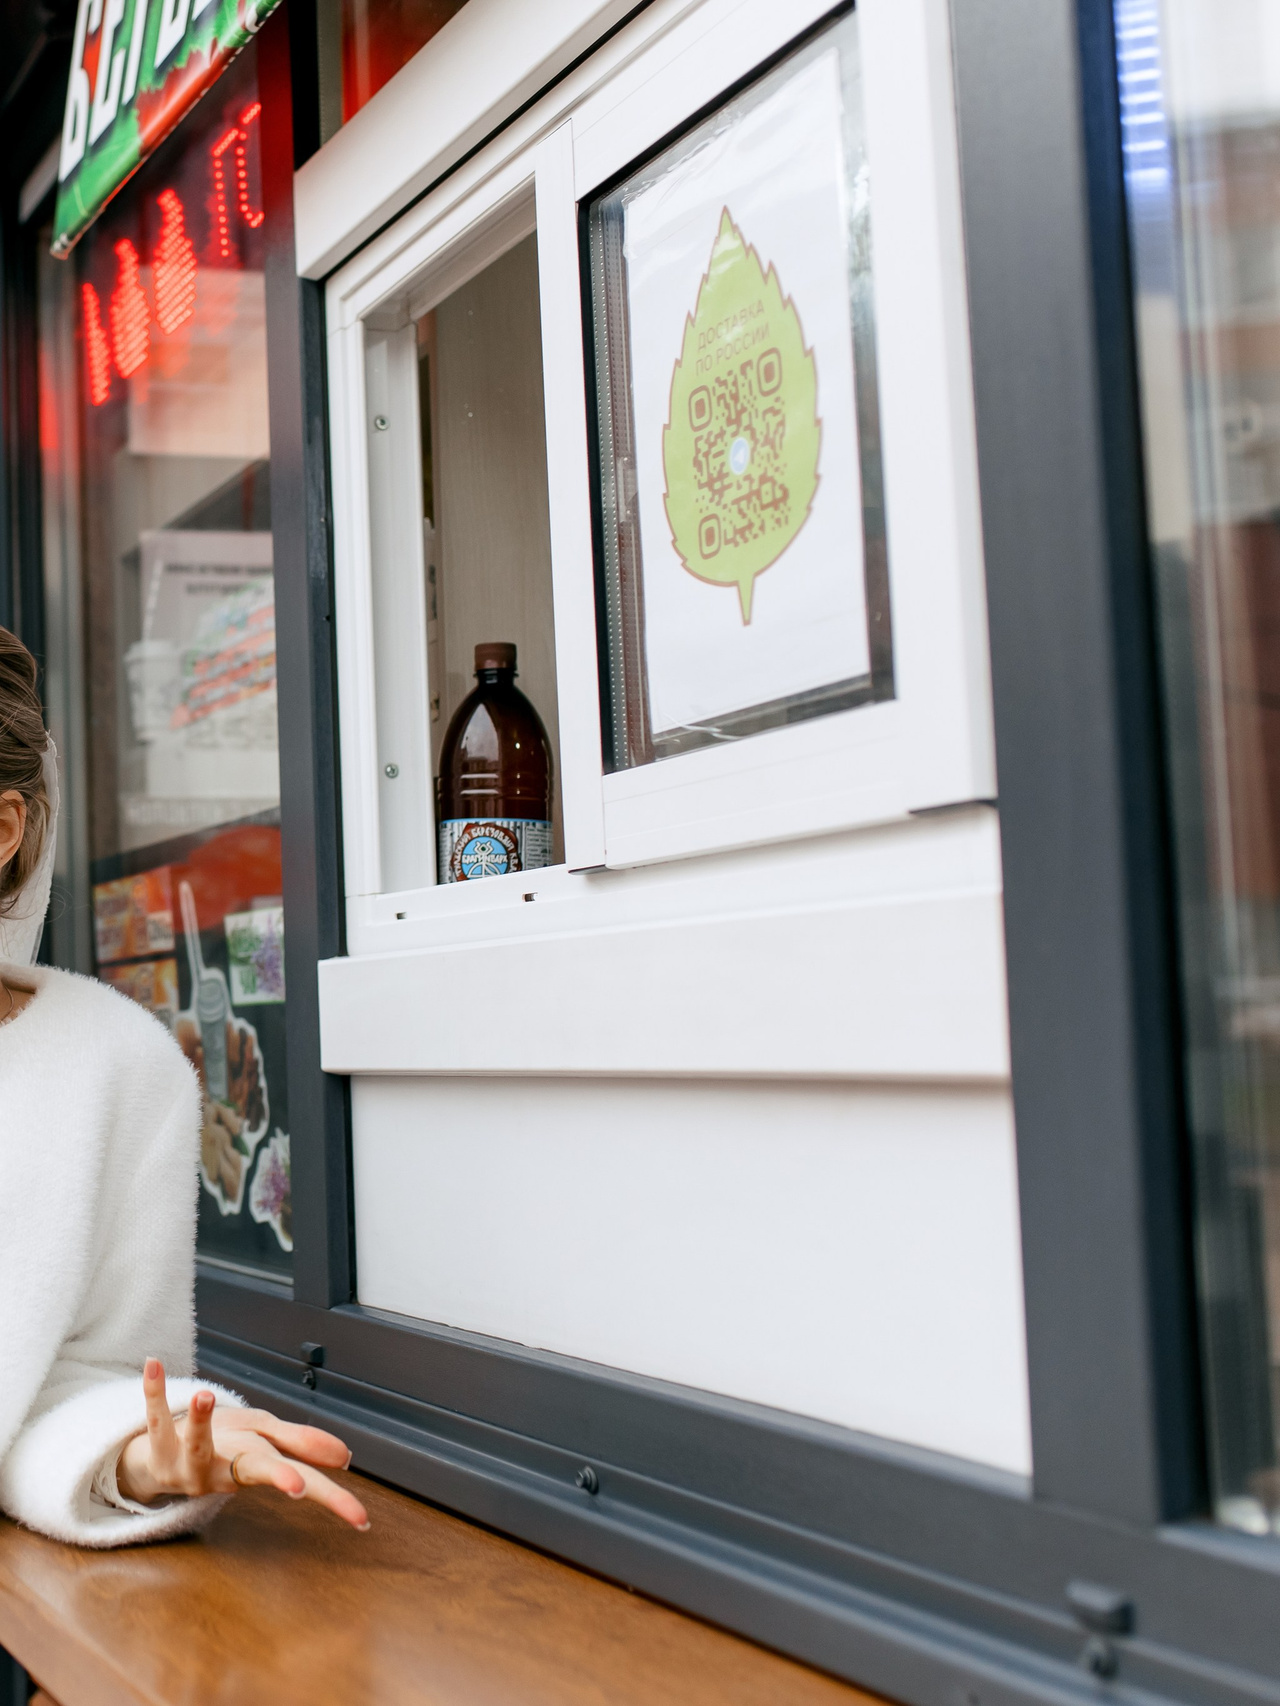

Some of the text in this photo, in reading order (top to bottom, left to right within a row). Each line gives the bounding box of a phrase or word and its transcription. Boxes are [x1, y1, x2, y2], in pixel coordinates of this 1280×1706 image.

[696, 321, 770, 376] ПО РОССИИ
[698, 299, 764, 352] ДОСТАВКА
